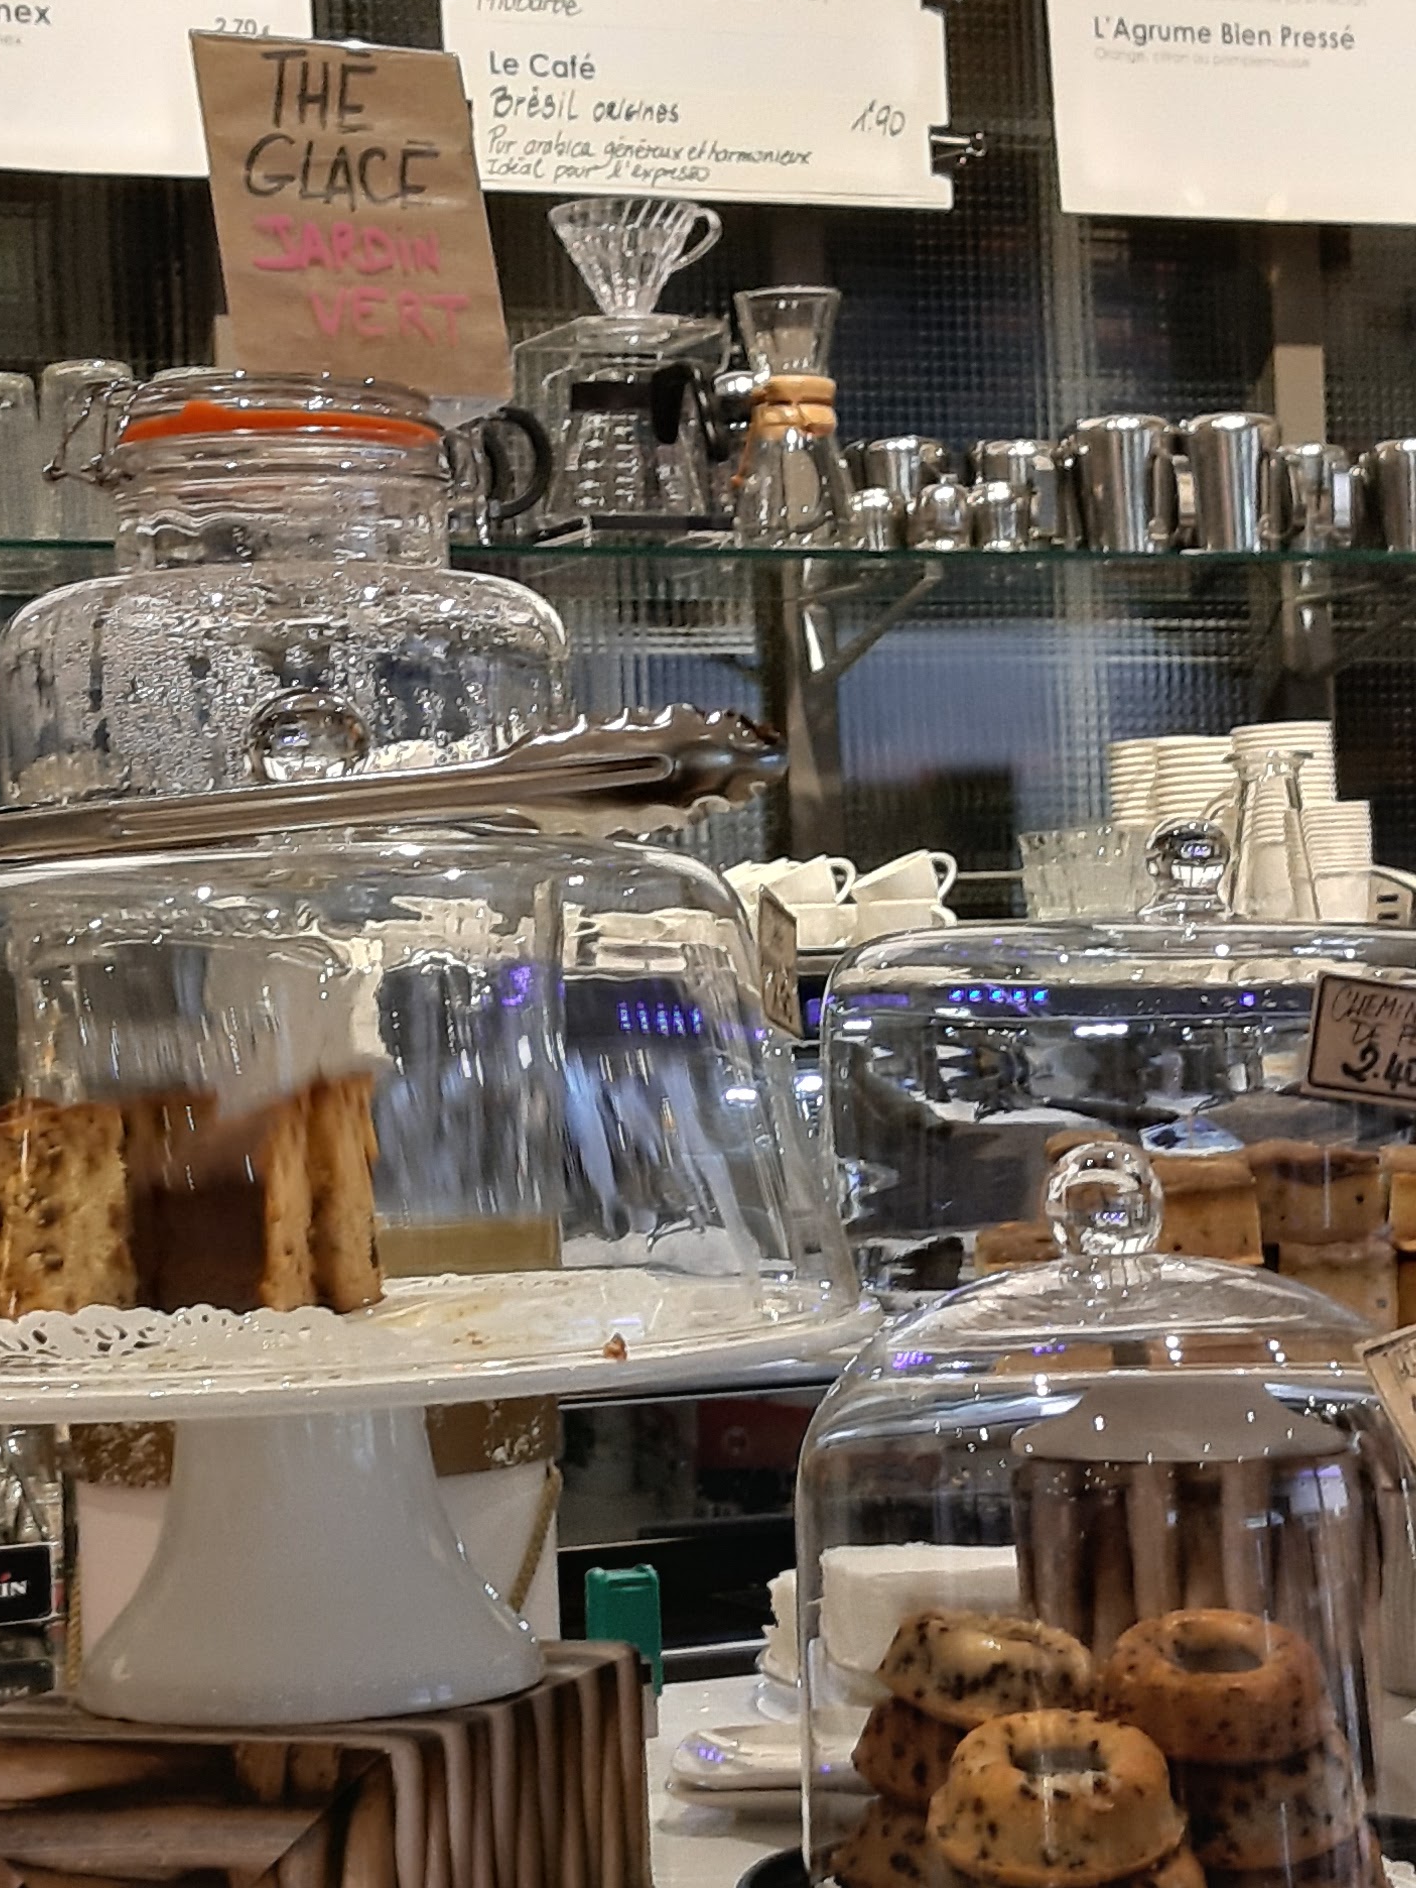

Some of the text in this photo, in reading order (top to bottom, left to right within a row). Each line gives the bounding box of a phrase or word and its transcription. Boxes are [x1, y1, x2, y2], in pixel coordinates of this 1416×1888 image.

[1094, 16, 1354, 50] L'Agrume Bien Pressé
[490, 51, 595, 80] Le Café
[310, 286, 470, 348] VERT
